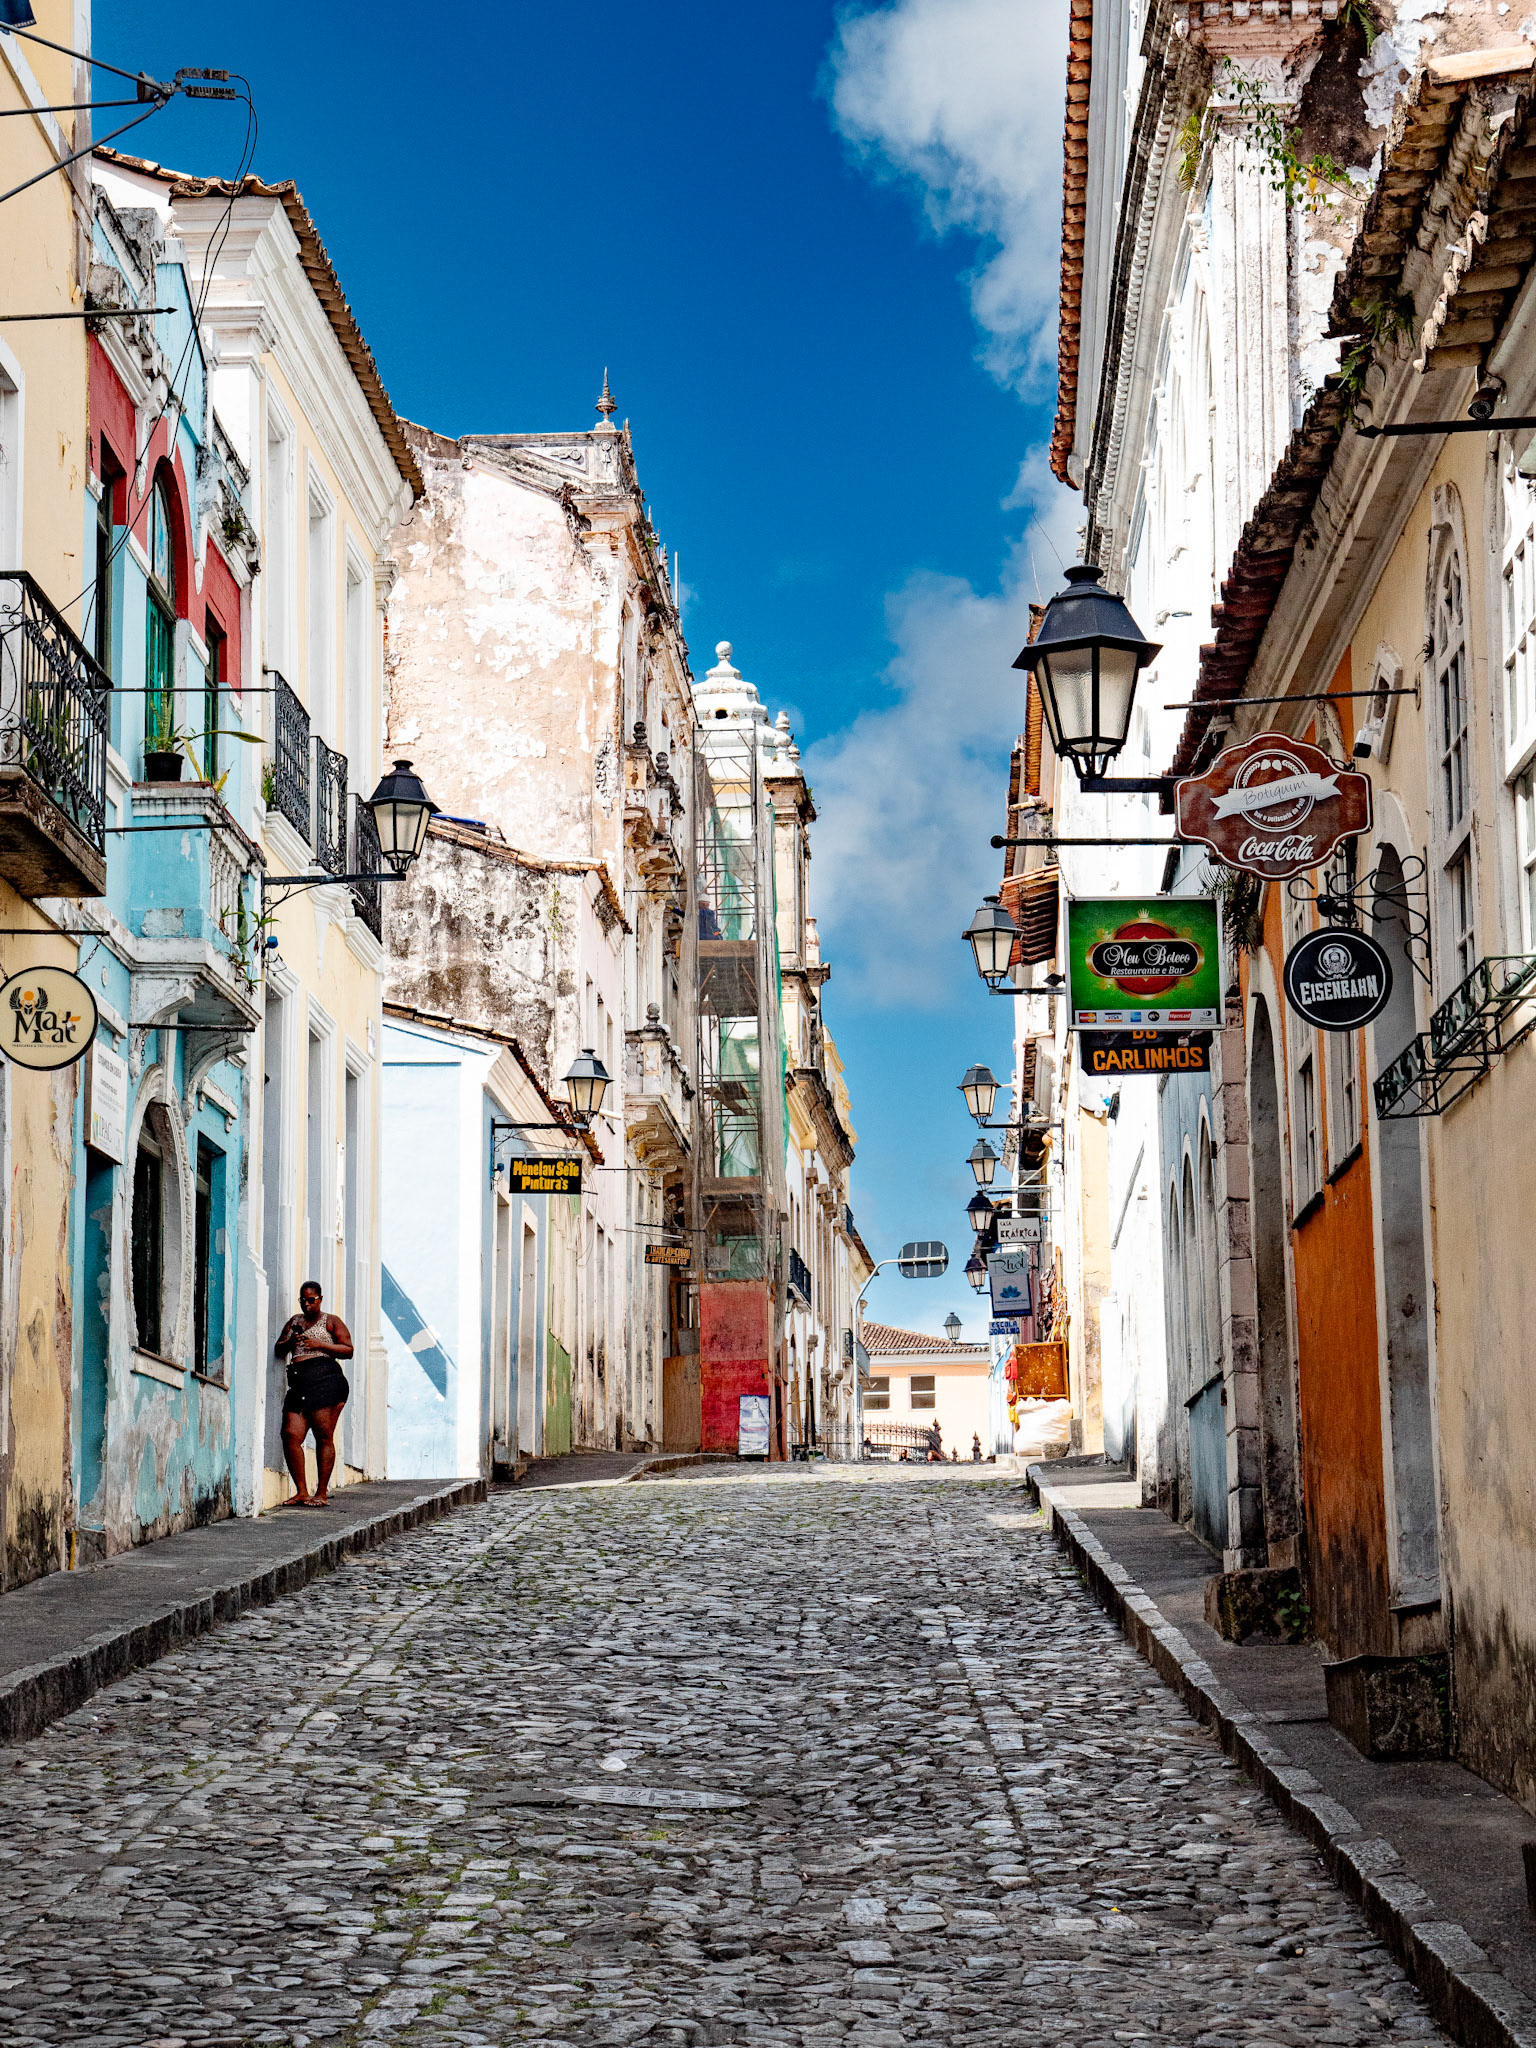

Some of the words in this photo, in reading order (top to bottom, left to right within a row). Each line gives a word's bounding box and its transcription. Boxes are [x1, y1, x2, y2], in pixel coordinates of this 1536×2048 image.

[1243, 780, 1308, 806] Botiquim
[1238, 834, 1318, 862] Coca-Cola
[1103, 944, 1140, 967] Meu
[1143, 944, 1190, 967] Boteco
[1110, 967, 1160, 976] Restaurante
[1168, 966, 1185, 975] Bar
[1300, 975, 1379, 1006] EISENBAHN
[1093, 1047, 1203, 1071] CARLINHOS
[556, 1161, 579, 1177] Sete
